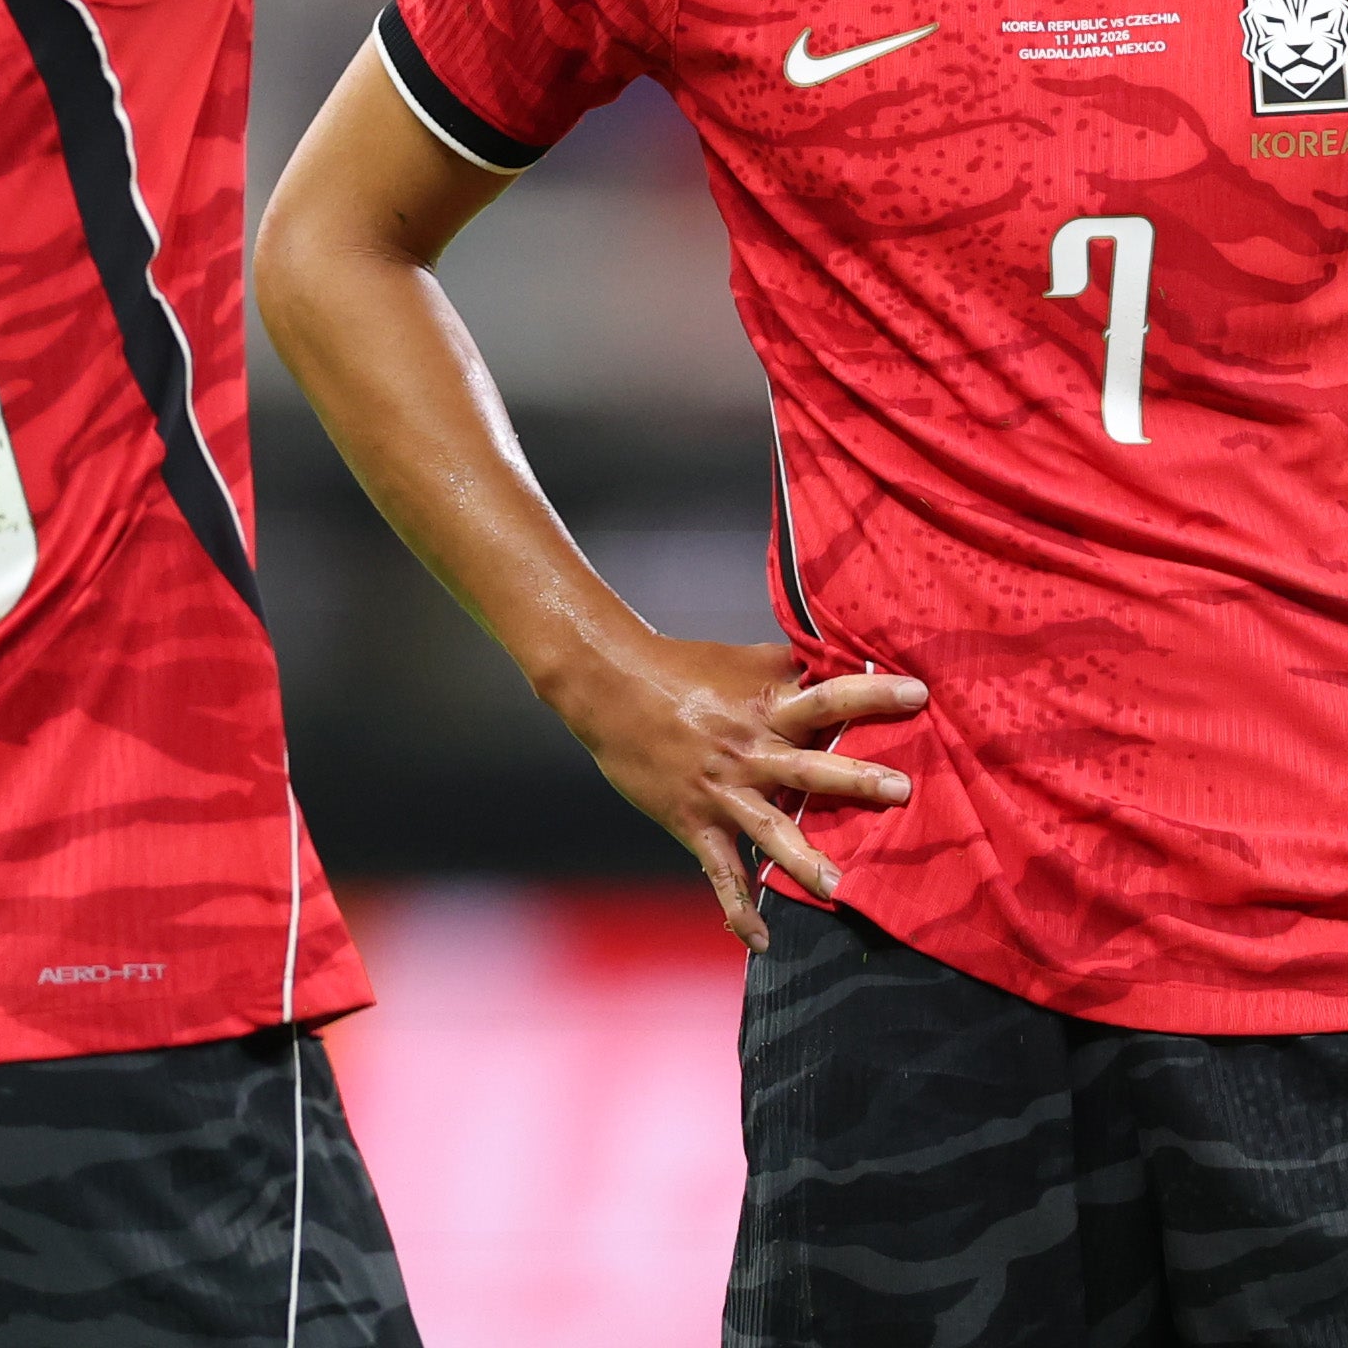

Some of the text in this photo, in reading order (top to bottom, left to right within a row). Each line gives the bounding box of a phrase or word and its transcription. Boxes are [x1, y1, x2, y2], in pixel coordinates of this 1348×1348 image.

[1002, 21, 1045, 33] KOREA
[1047, 17, 1109, 32] REPUBLIC
[1125, 12, 1181, 27] CZECHIA
[1055, 30, 1131, 46] 11 JUN 2026
[1019, 41, 1167, 60] GUADALAJARA, MEXICO
[1042, 214, 1156, 445] 7
[37, 963, 168, 986] AERO-FIT
